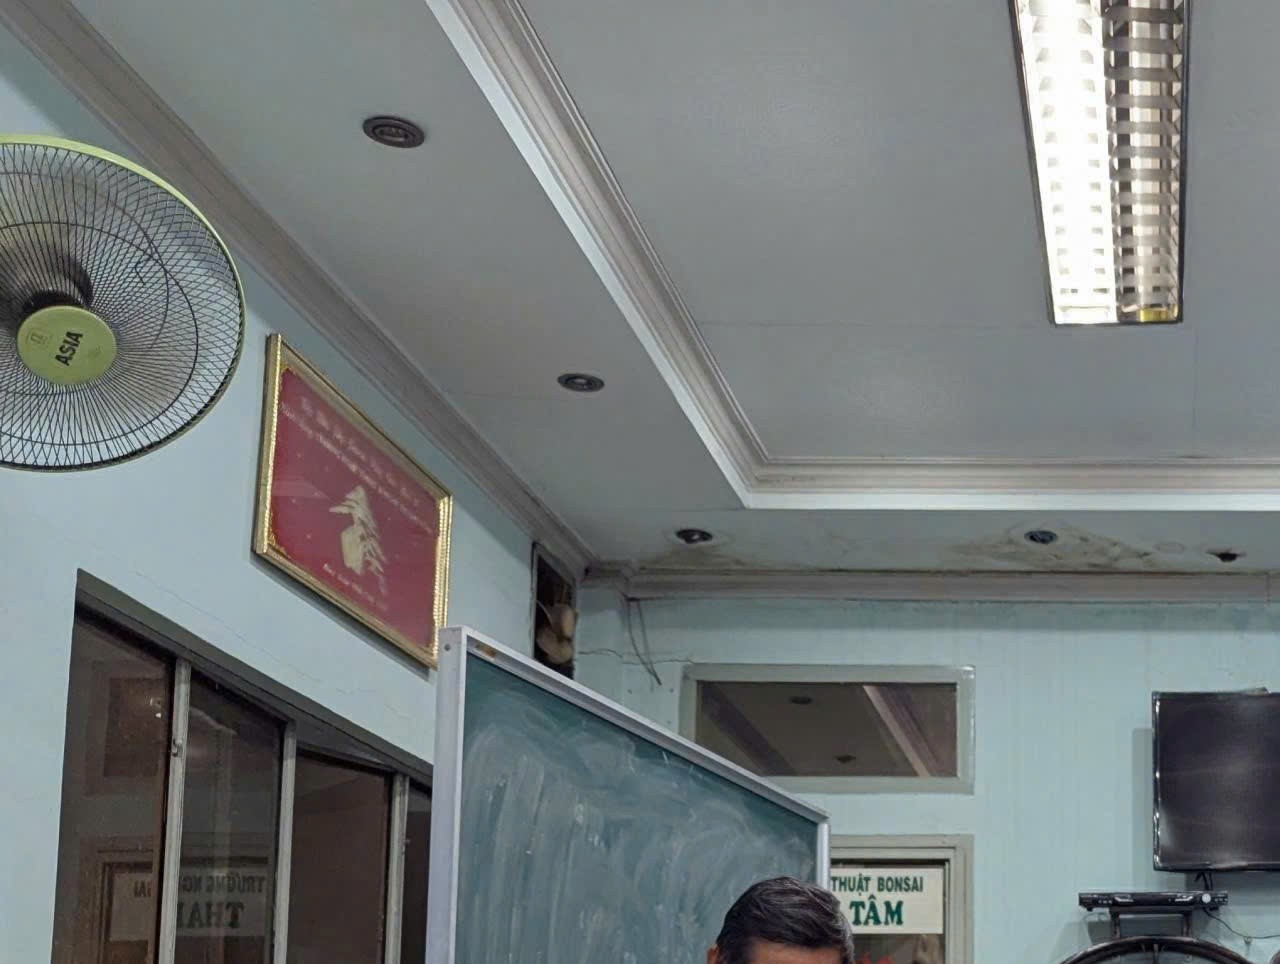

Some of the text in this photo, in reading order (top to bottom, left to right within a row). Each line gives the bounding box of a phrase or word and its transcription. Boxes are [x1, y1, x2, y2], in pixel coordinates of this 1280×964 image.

[55, 331, 83, 366] ASIA
[831, 873, 924, 896] THUẬT BONSAI
[849, 894, 904, 926] TÂM
